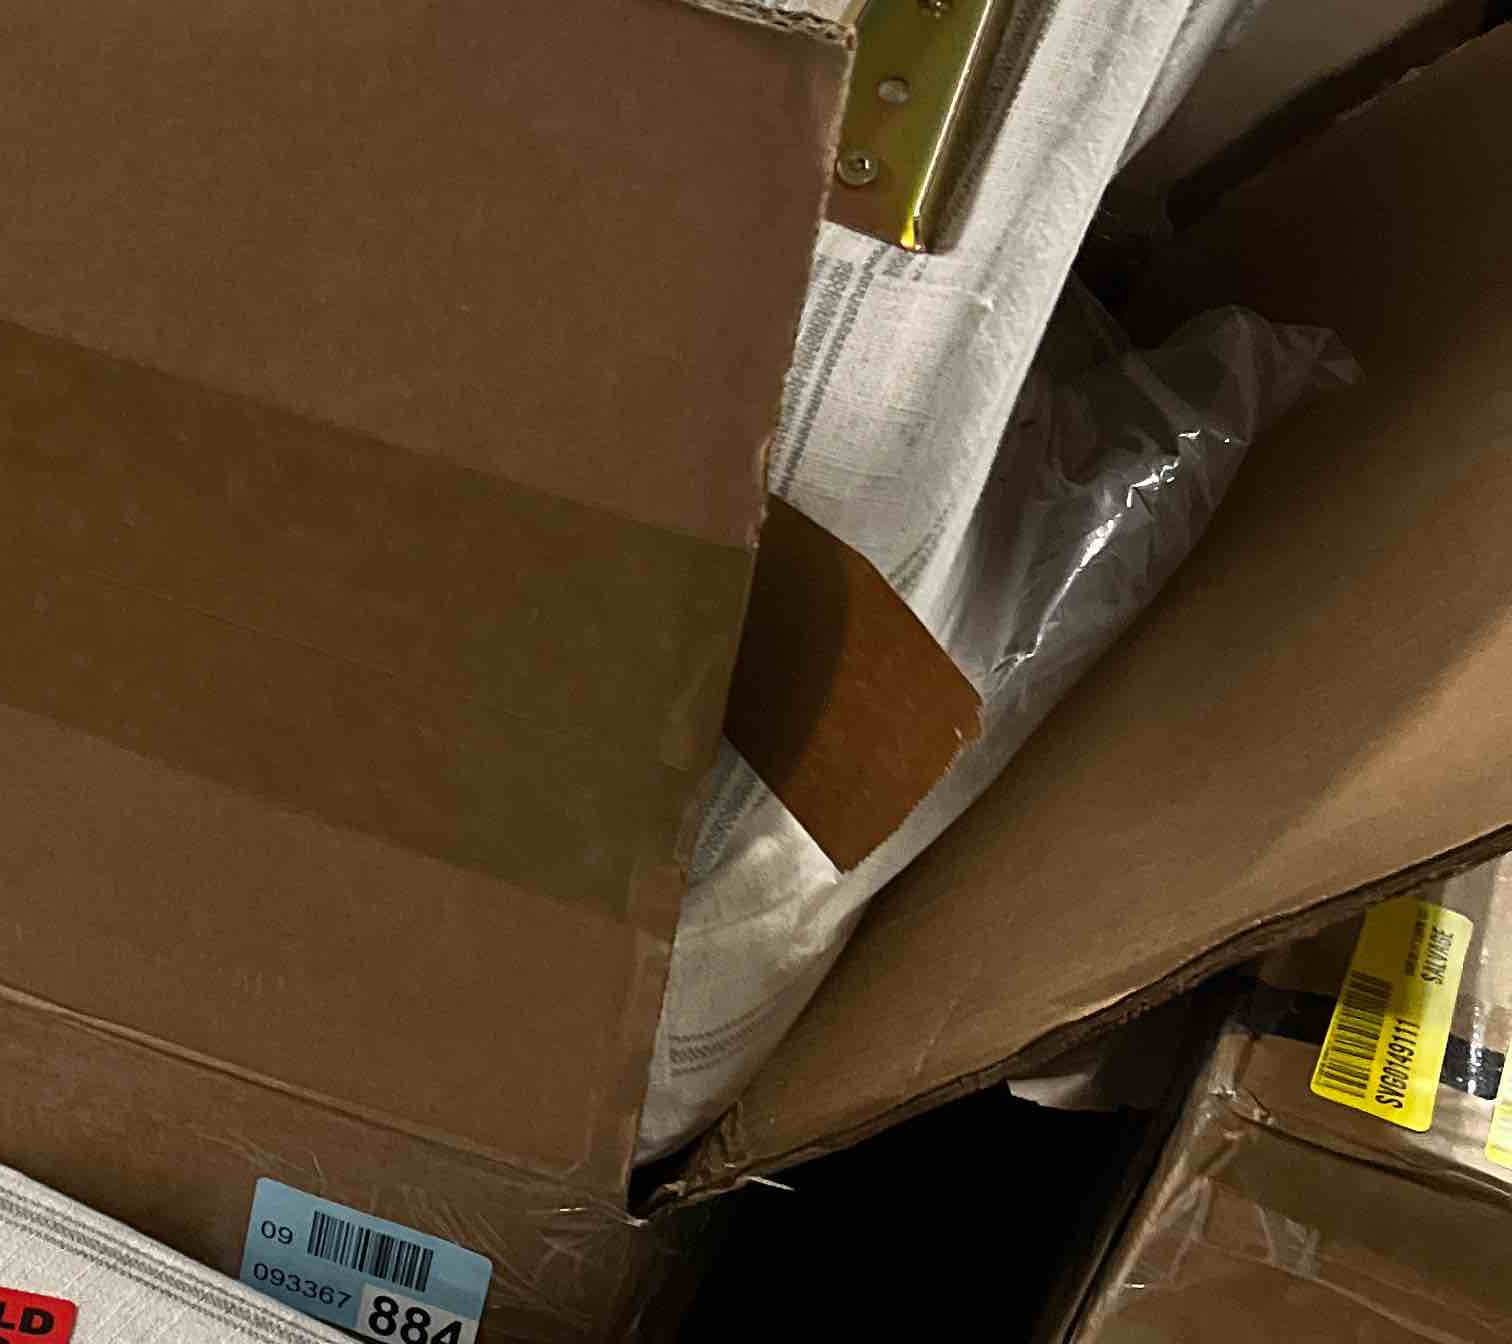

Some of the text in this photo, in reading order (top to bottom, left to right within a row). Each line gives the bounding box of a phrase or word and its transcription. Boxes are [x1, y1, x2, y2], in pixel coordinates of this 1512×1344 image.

[1421, 927, 1454, 985] SALVAGE
[1376, 1018, 1421, 1109] SVG0149111
[261, 1220, 294, 1245] 09
[253, 1263, 352, 1308] 093367
